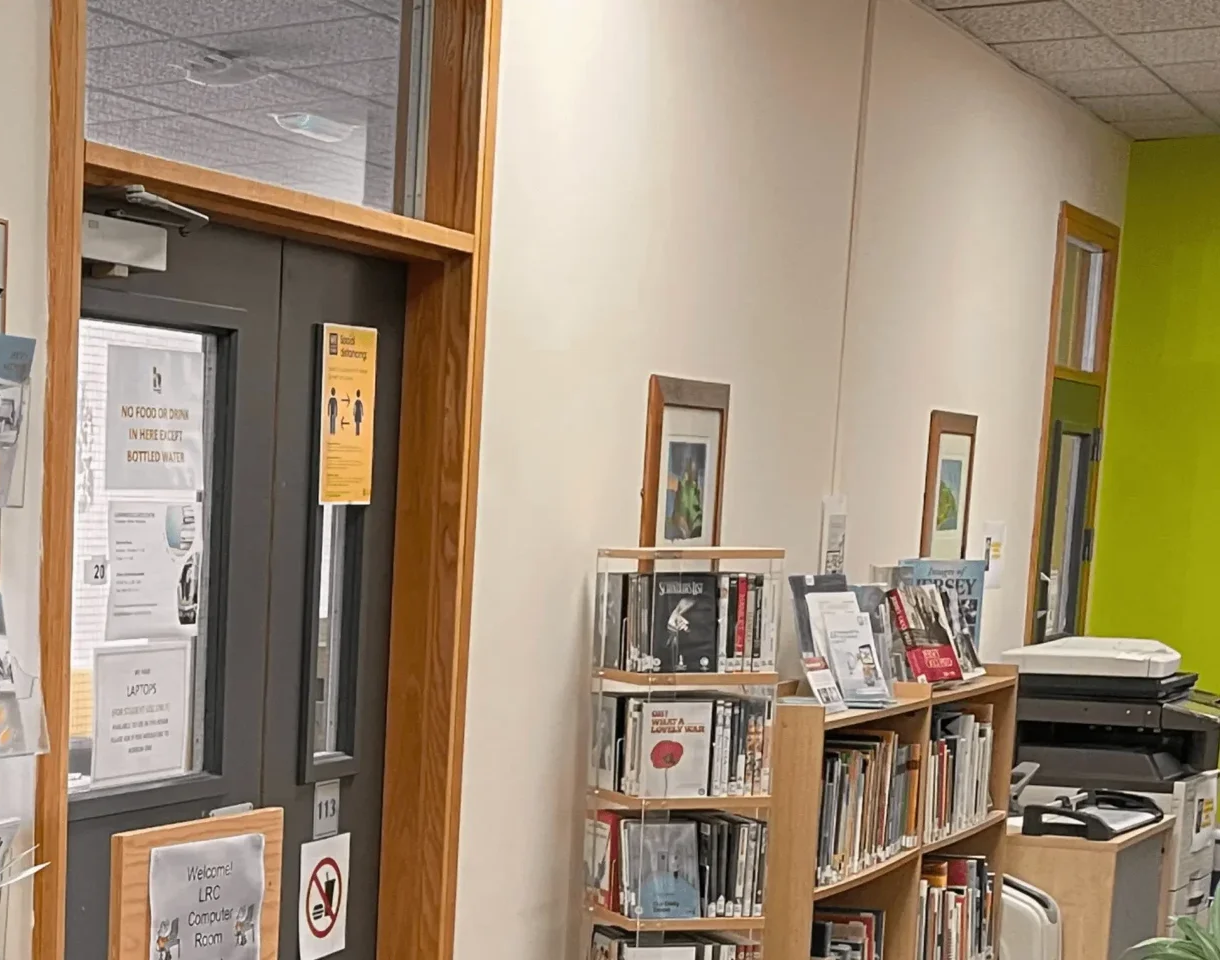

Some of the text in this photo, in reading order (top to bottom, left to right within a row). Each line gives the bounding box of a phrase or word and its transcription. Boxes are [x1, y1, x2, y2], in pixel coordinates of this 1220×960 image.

[121, 405, 190, 420] NO FOOD OR DRINK
[128, 428, 183, 442] IN HERE EXCEPT
[127, 450, 185, 463] BOTTLED WATER
[93, 564, 106, 579] 20
[126, 683, 157, 698] LAPTOPS
[650, 725, 705, 734] LOVELY WAR
[651, 718, 685, 726] WHAT A
[318, 798, 336, 820] 113
[186, 861, 234, 882] Welcome!
[198, 885, 221, 903] LRC
[188, 907, 234, 927] Computer
[194, 932, 223, 948] Room
